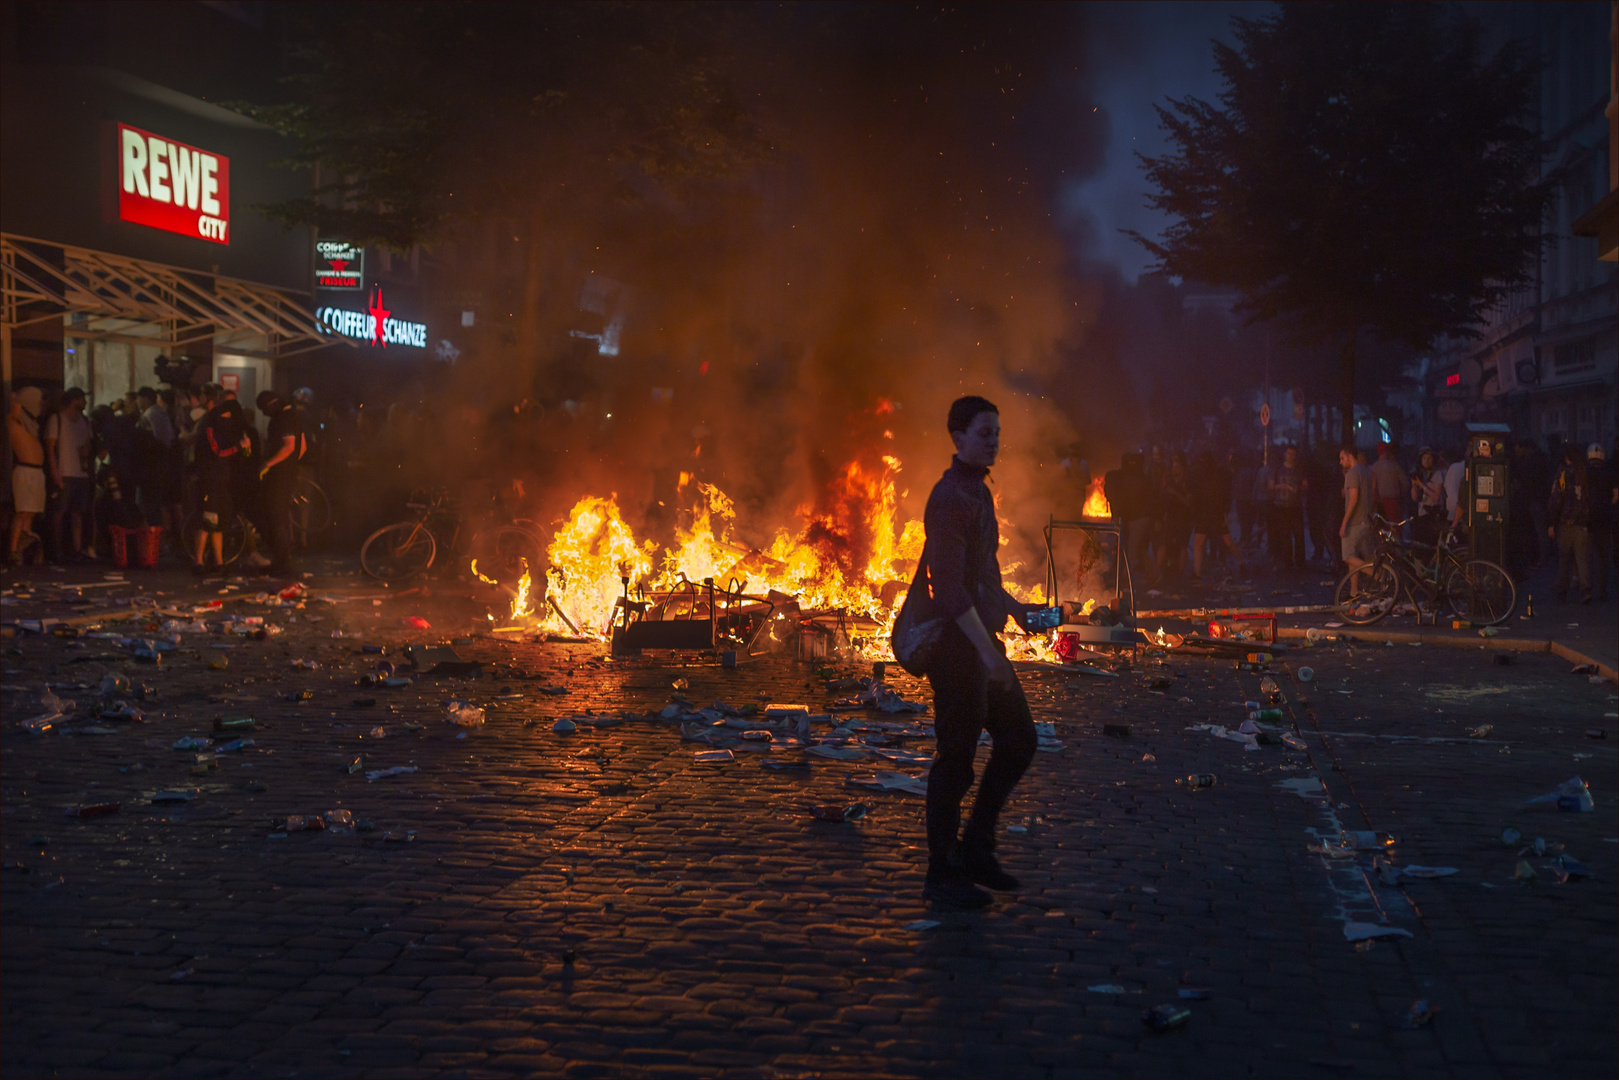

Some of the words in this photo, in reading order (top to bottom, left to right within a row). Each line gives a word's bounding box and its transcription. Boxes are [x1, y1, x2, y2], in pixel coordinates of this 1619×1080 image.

[121, 128, 221, 216] REWE
[198, 215, 227, 241] CITY
[320, 276, 357, 287] FRISEUR
[322, 307, 377, 340] COIFFEUR
[382, 318, 427, 348] SCHANZE
